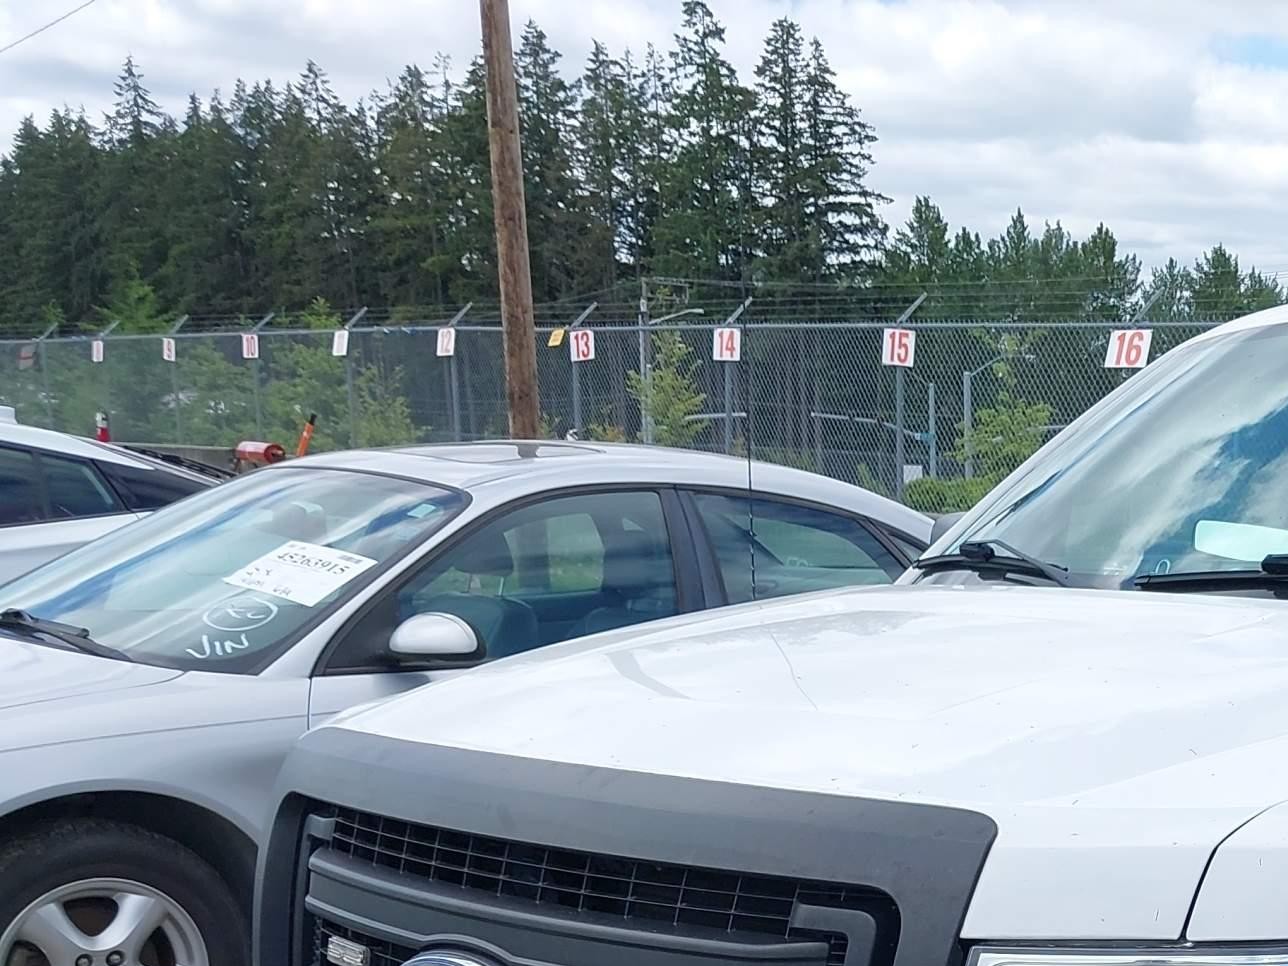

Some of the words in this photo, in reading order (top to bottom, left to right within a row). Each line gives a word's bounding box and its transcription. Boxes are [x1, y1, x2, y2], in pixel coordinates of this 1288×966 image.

[440, 329, 452, 354] 12
[573, 331, 591, 359] 13
[718, 329, 736, 358] 14
[889, 330, 910, 364] 15
[1114, 331, 1145, 366] 16
[185, 632, 250, 659] VIN
